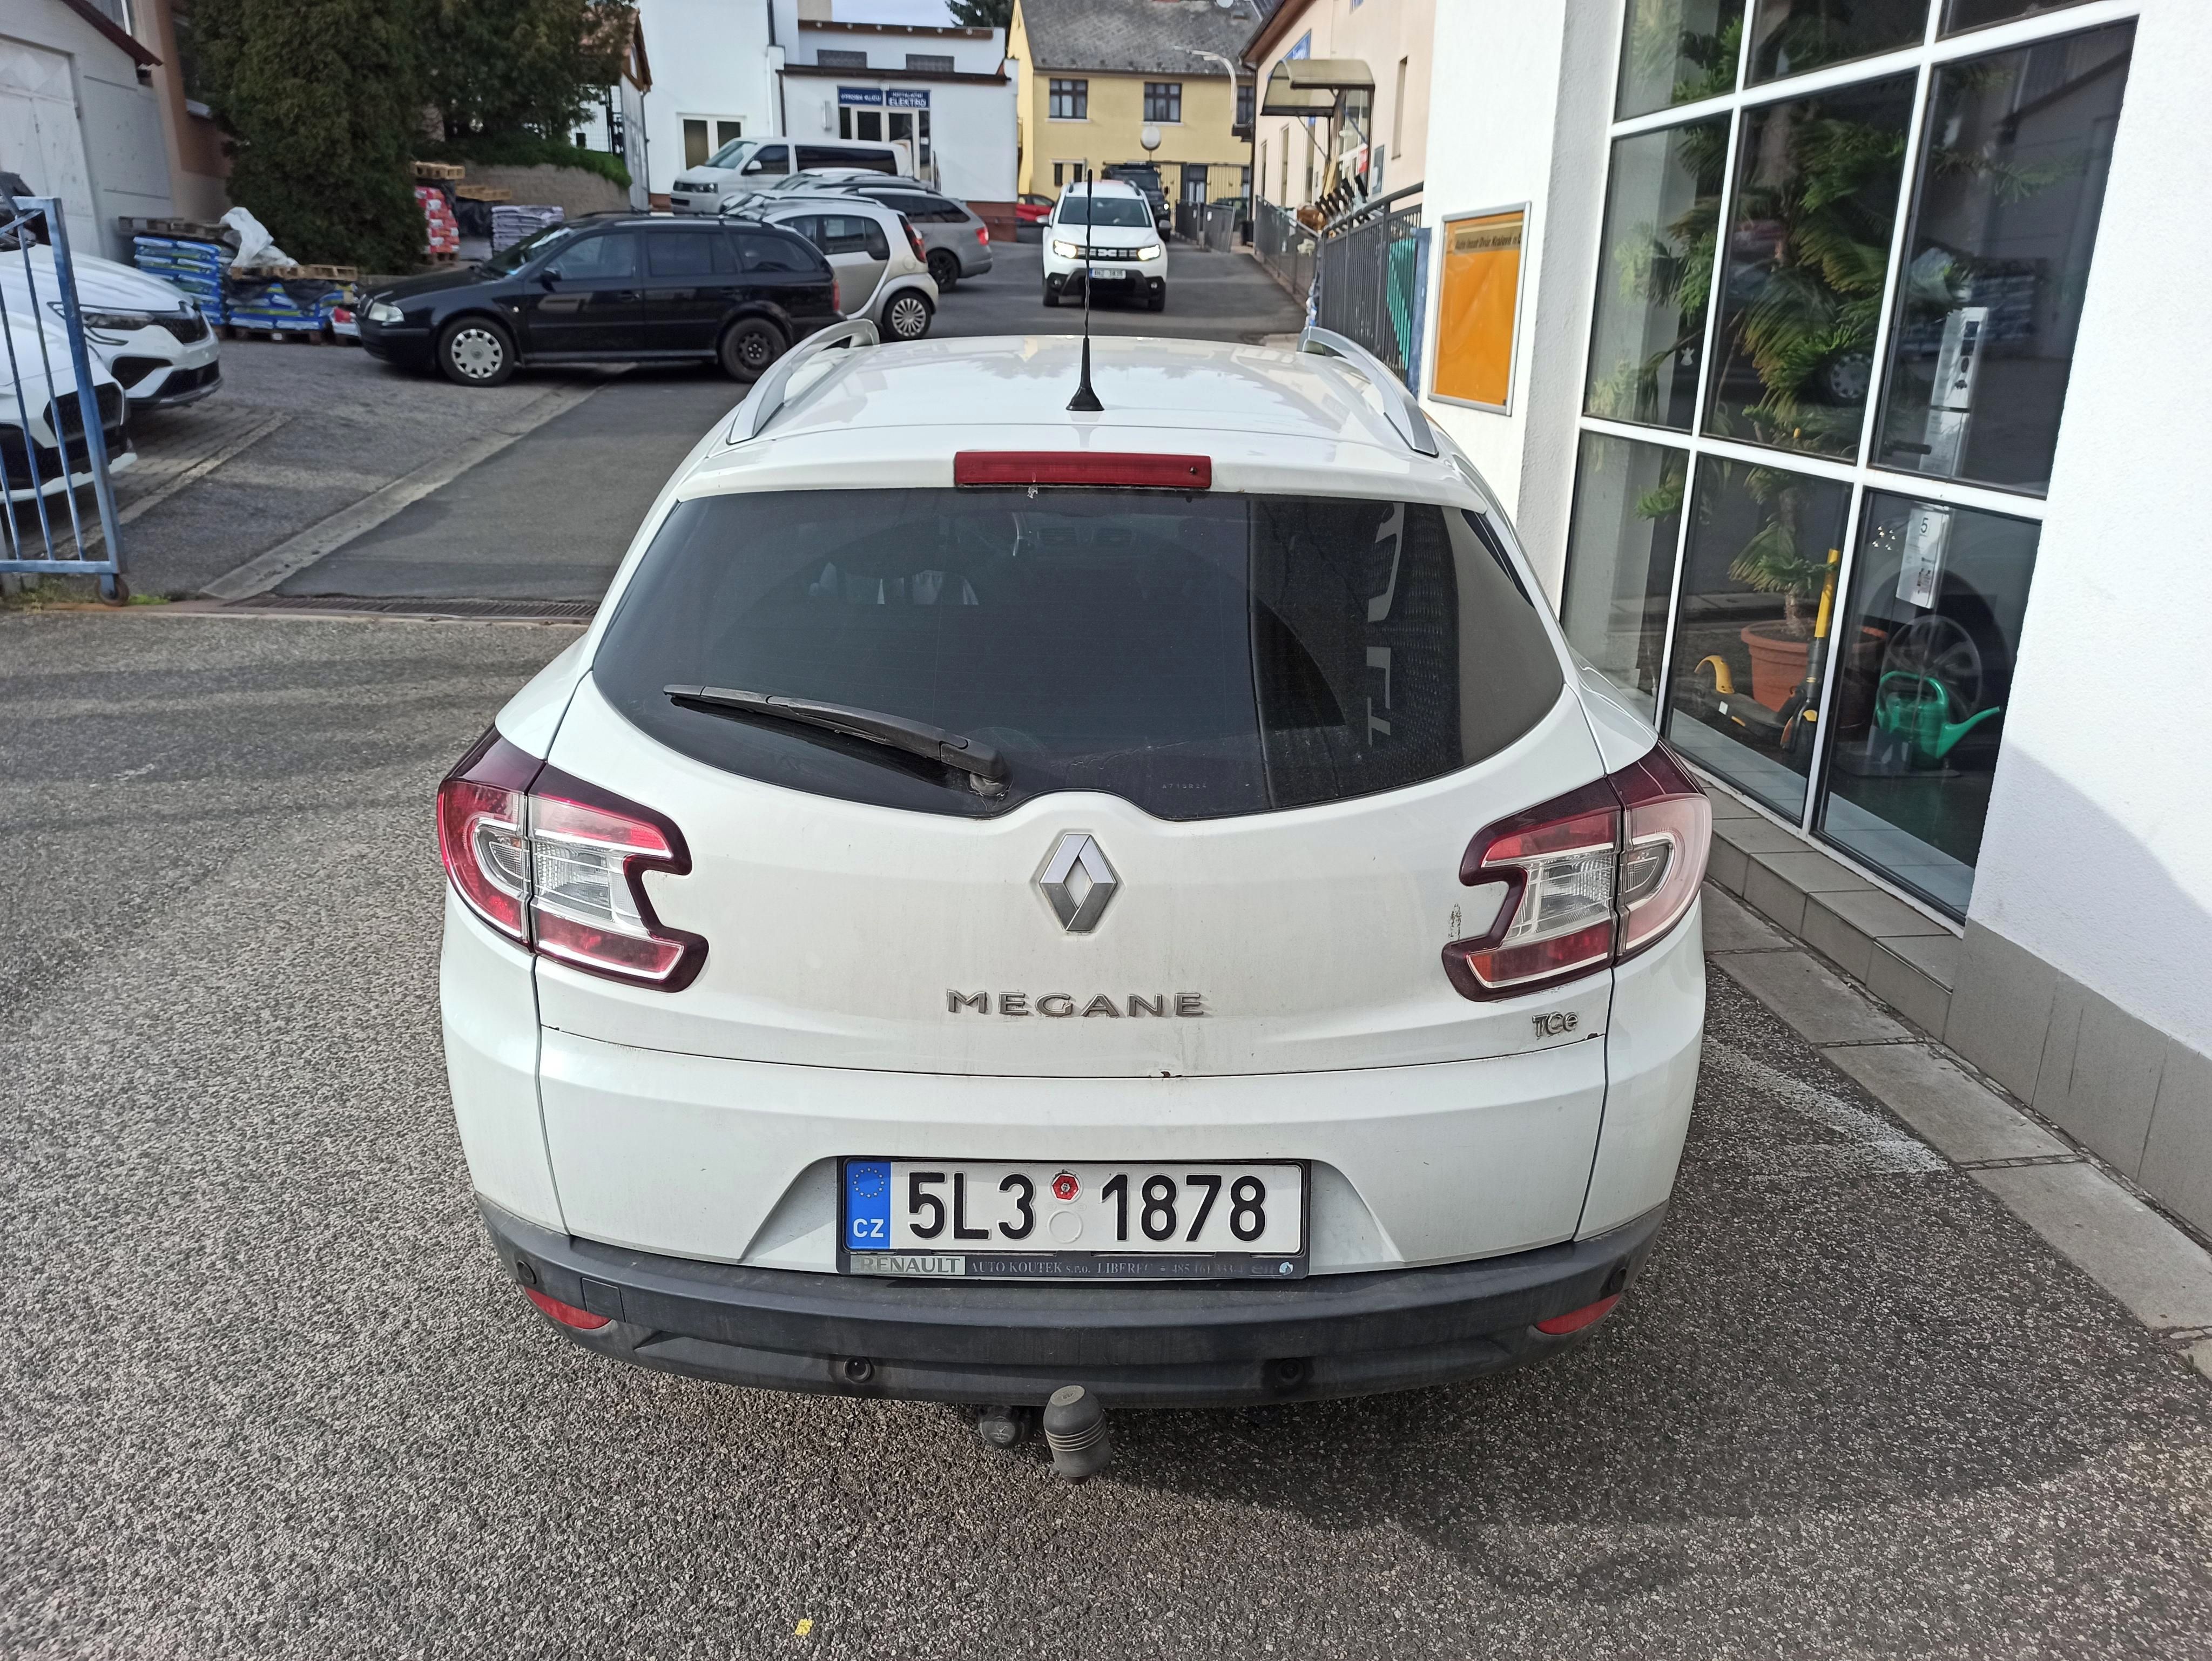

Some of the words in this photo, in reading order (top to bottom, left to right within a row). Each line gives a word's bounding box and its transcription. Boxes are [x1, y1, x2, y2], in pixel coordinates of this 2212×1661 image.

[1920, 517, 1928, 533] 5
[946, 989, 1204, 1018] MEGANE
[1532, 1011, 1579, 1038] TCe
[909, 1172, 1034, 1240] 5L3
[1102, 1173, 1266, 1241] 1878
[853, 1218, 884, 1238] CZ
[860, 1257, 960, 1273] RENAULT
[972, 1261, 1005, 1273] AUTO
[1009, 1261, 1062, 1274] KOUTEK
[1065, 1265, 1090, 1274] s.r.o.
